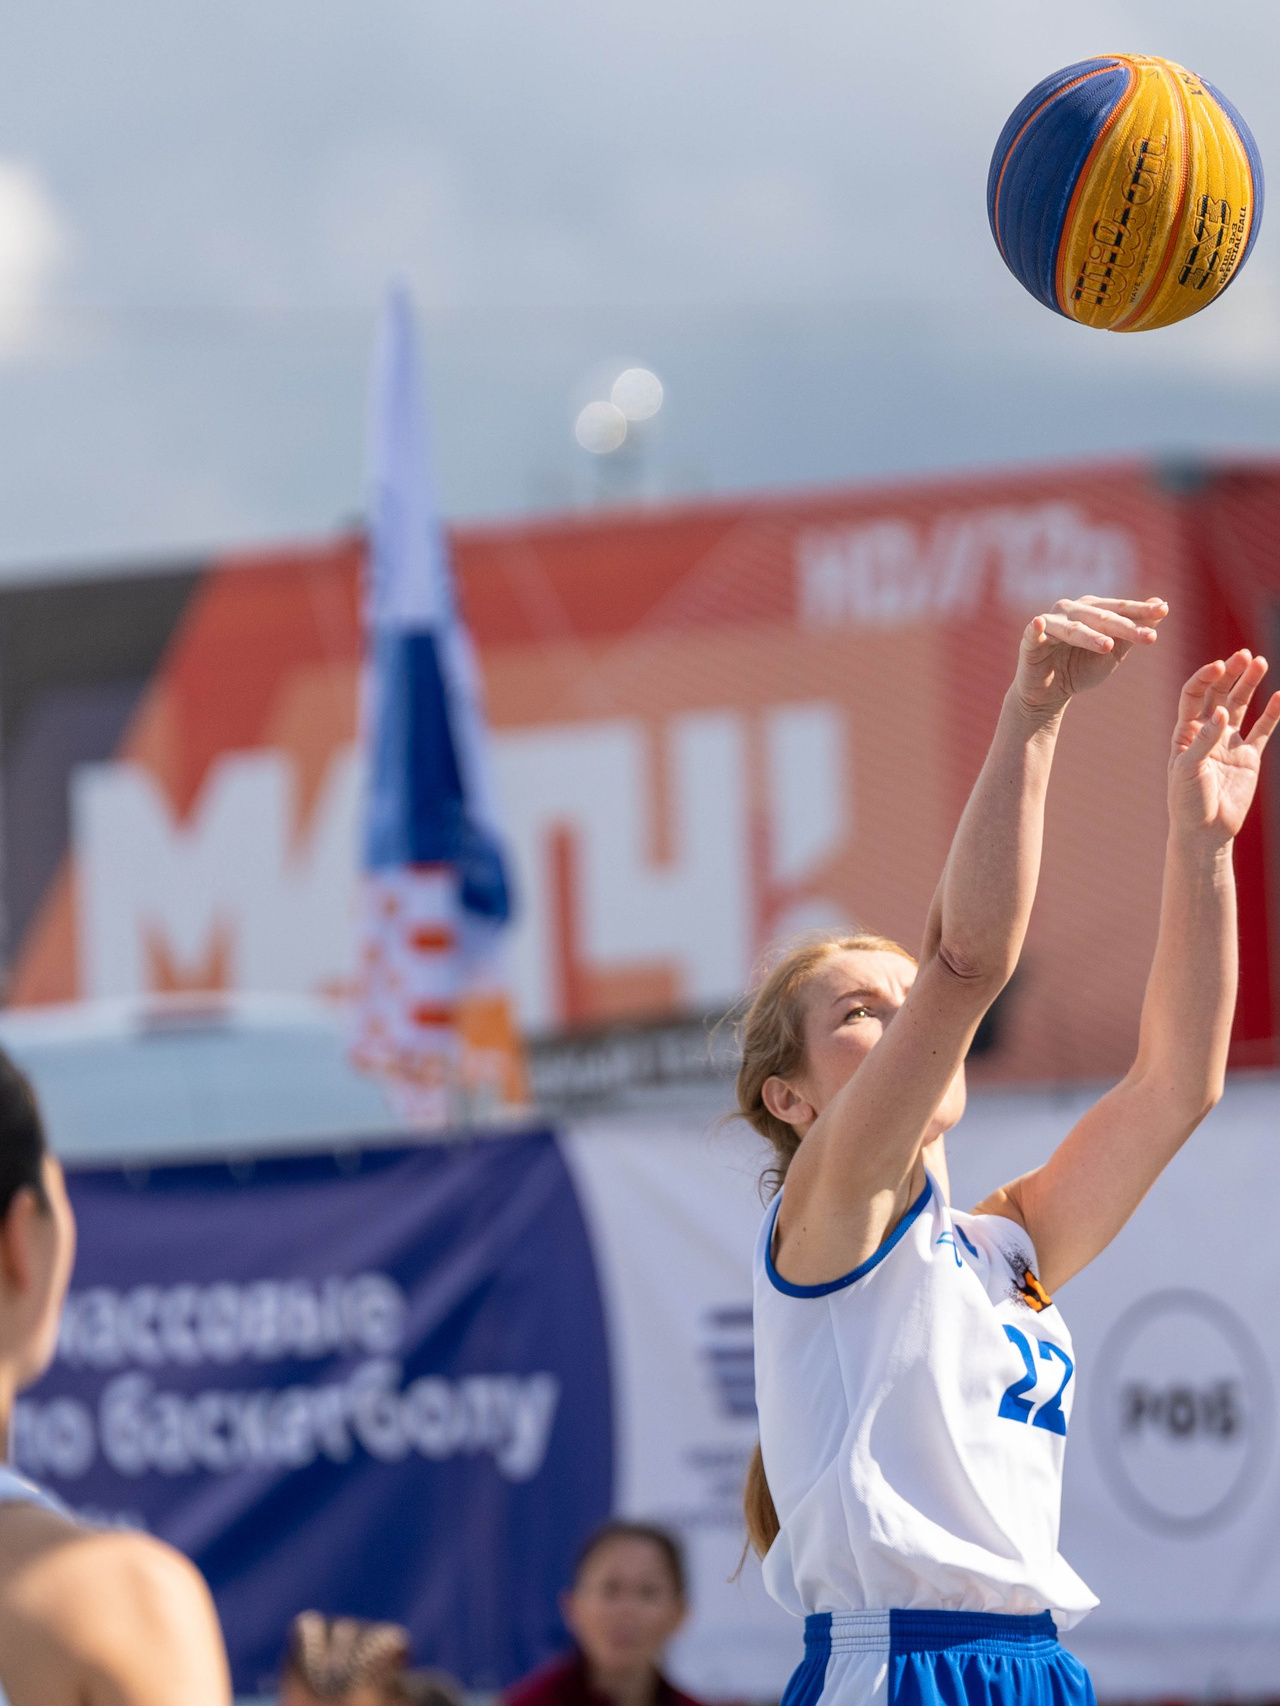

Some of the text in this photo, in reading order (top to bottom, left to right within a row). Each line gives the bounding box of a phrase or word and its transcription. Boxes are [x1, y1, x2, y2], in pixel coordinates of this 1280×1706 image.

[1071, 136, 1168, 309] Wilson
[1219, 236, 1243, 285] OFFICIAL
[1129, 281, 1141, 304] WAVE
[102, 1362, 560, 1482] баскетболу
[998, 1323, 1074, 1437] 22
